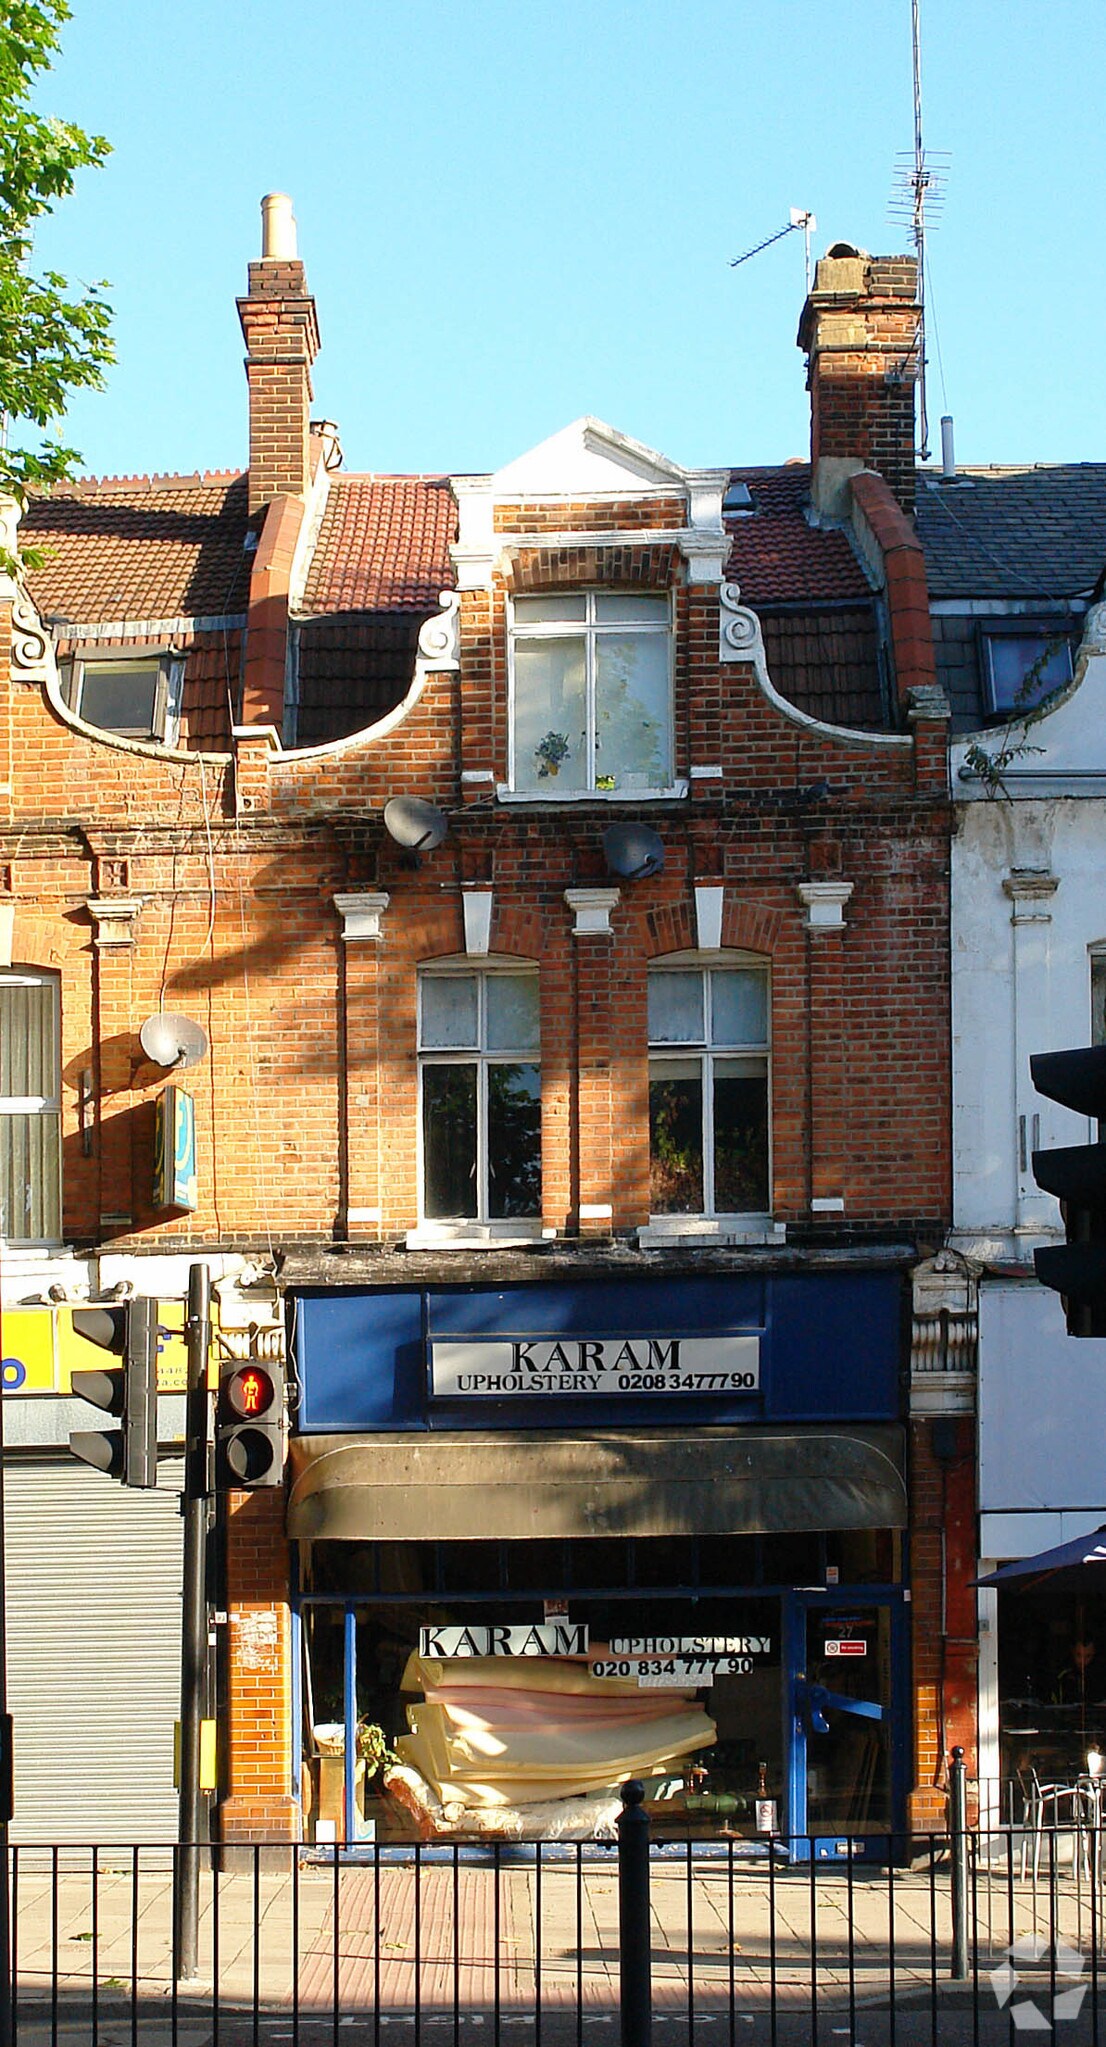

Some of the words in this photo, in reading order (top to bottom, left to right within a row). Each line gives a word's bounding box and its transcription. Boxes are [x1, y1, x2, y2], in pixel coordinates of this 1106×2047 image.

[510, 1340, 682, 1373] KARAM
[457, 1374, 602, 1391] UPHOLSTERY
[838, 1626, 853, 1638] 27
[422, 1626, 588, 1657] KARAM
[611, 1637, 770, 1654] UPHOLSTERY
[593, 1662, 631, 1677] 020
[637, 1661, 676, 1676] 834
[683, 1660, 720, 1675] 777
[727, 1659, 753, 1674] 90
